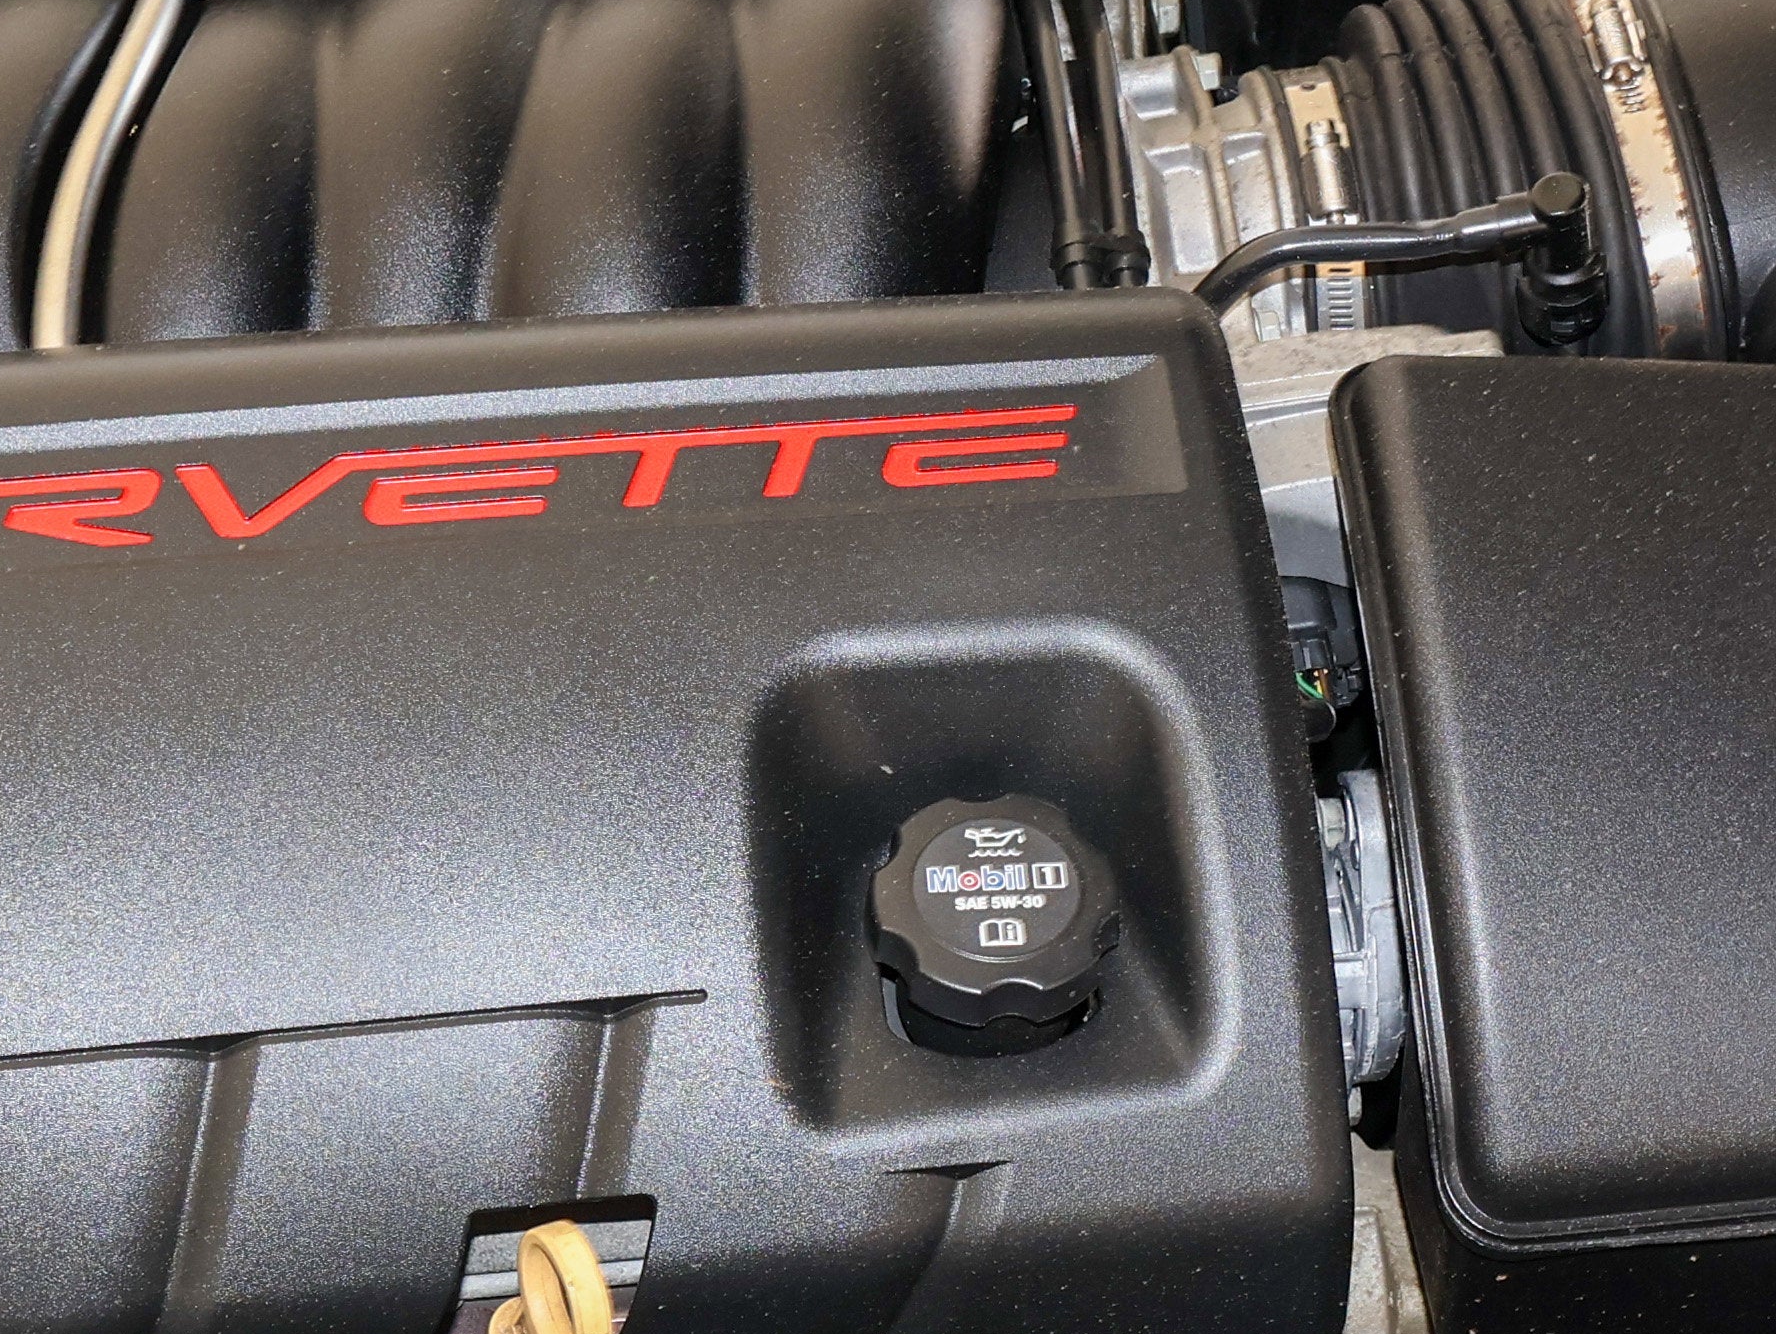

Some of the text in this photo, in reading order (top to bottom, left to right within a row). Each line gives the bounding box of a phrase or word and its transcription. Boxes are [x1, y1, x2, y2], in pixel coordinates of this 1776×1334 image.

[926, 864, 1026, 893] Mobil
[955, 895, 1044, 910] SAE 5W-30
